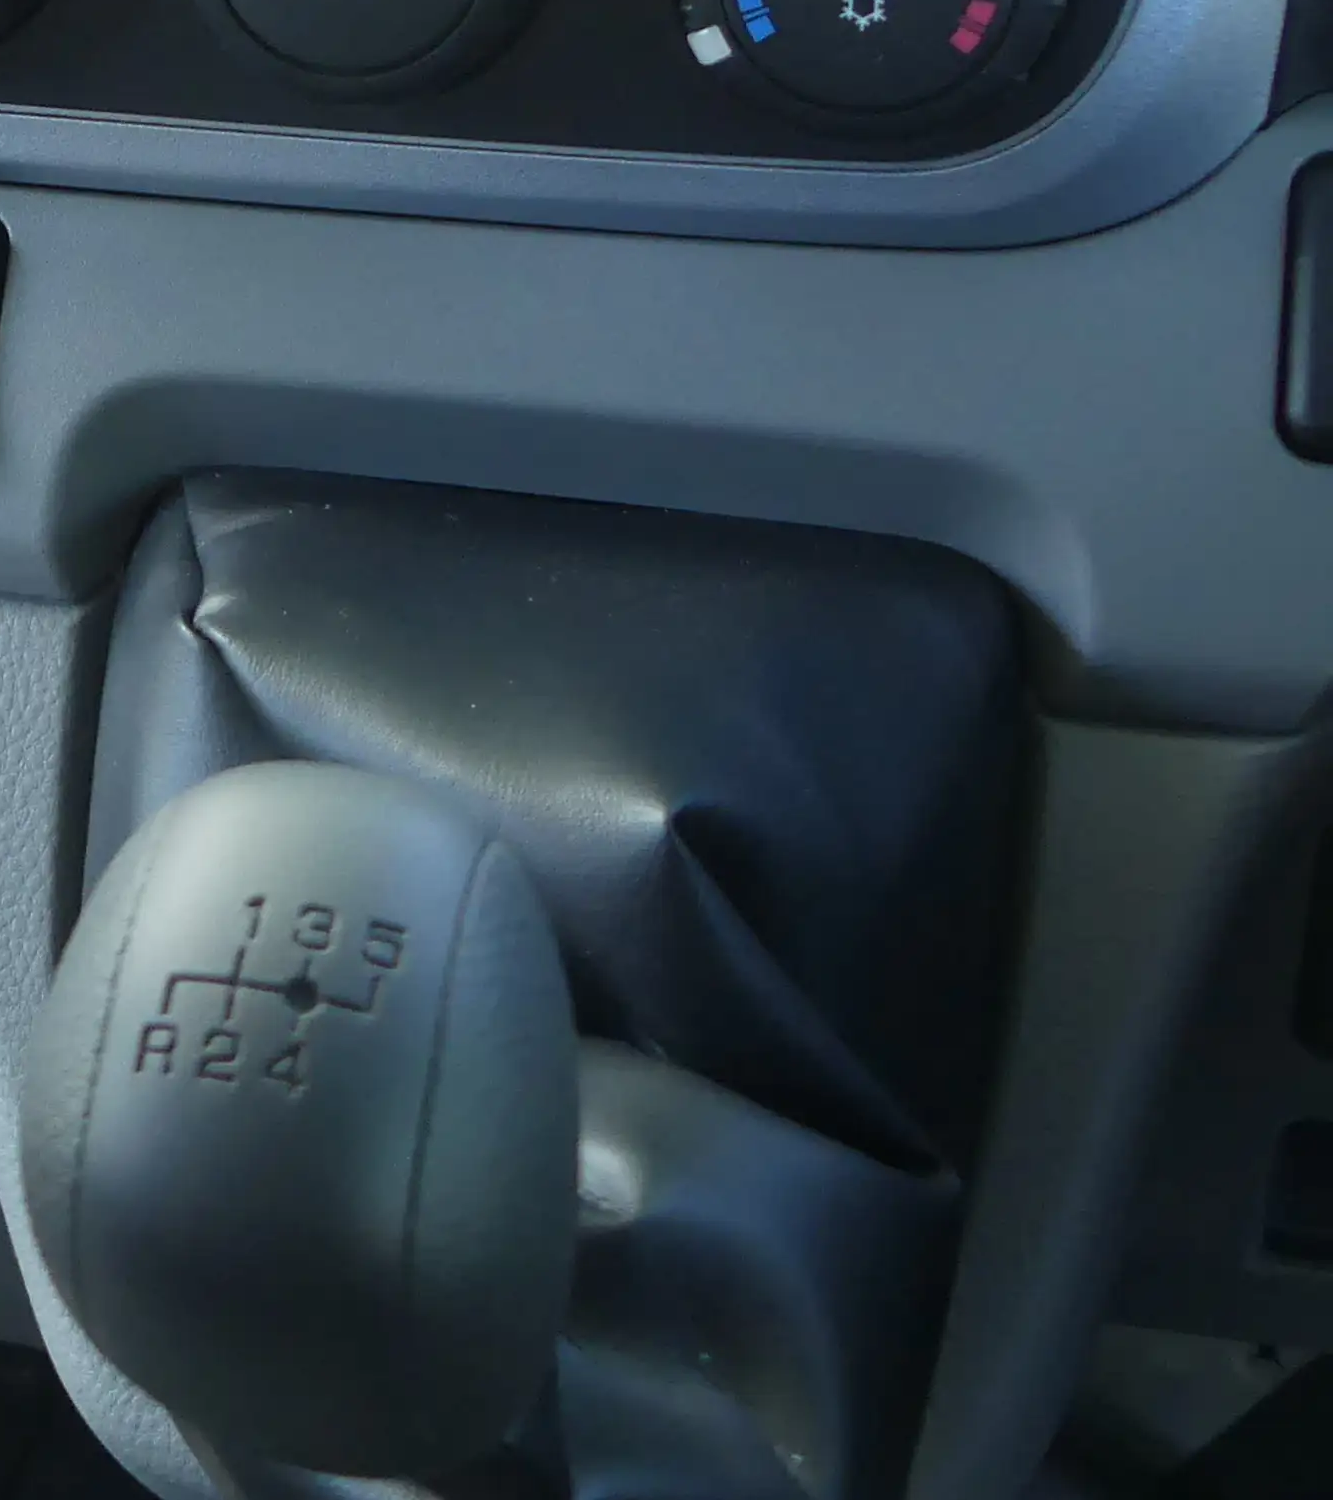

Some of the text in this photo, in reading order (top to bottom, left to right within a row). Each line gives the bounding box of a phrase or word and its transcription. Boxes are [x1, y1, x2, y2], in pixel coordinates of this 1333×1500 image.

[243, 894, 408, 971] 1 3 5
[134, 1022, 307, 1092] R 2 4
